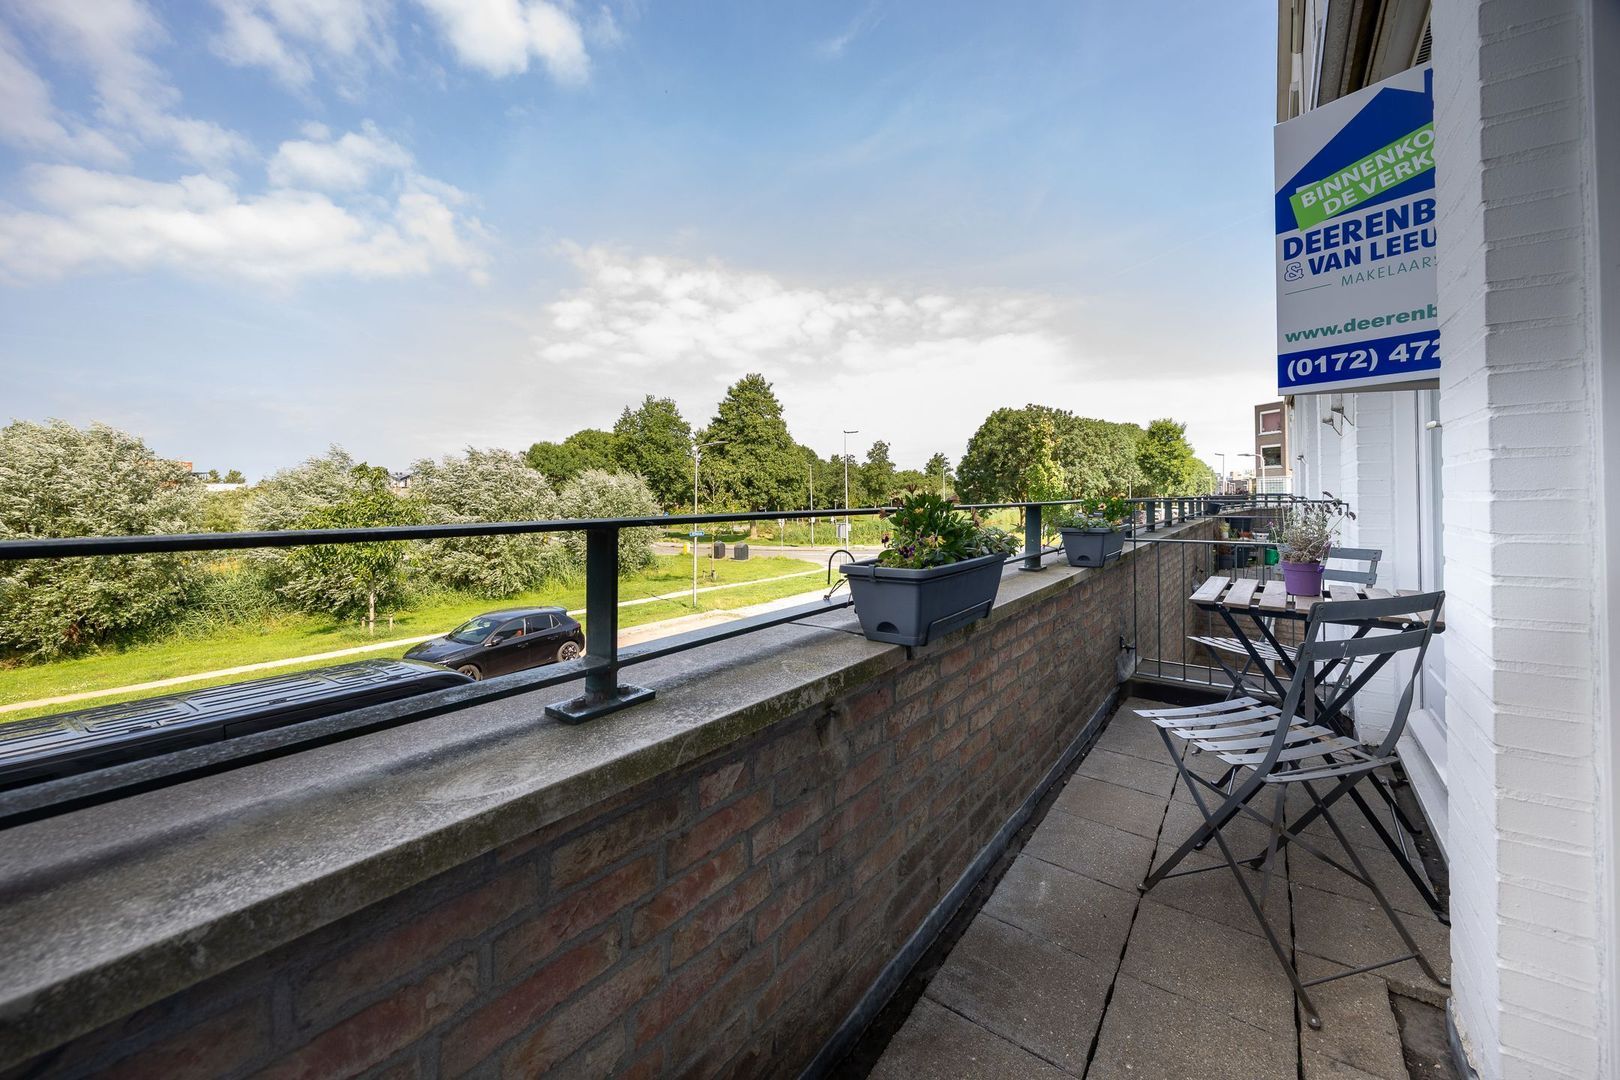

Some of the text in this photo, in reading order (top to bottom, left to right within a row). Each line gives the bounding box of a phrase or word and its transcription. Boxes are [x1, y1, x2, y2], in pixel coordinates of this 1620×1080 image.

[1301, 129, 1435, 208] BINNENKO
[1322, 149, 1436, 215] DE VERK
[1283, 198, 1437, 261] DEERENB
[1284, 226, 1437, 282] & VAN LEEU
[1285, 303, 1438, 343] www.deerenb
[1287, 348, 1379, 382] (0172)
